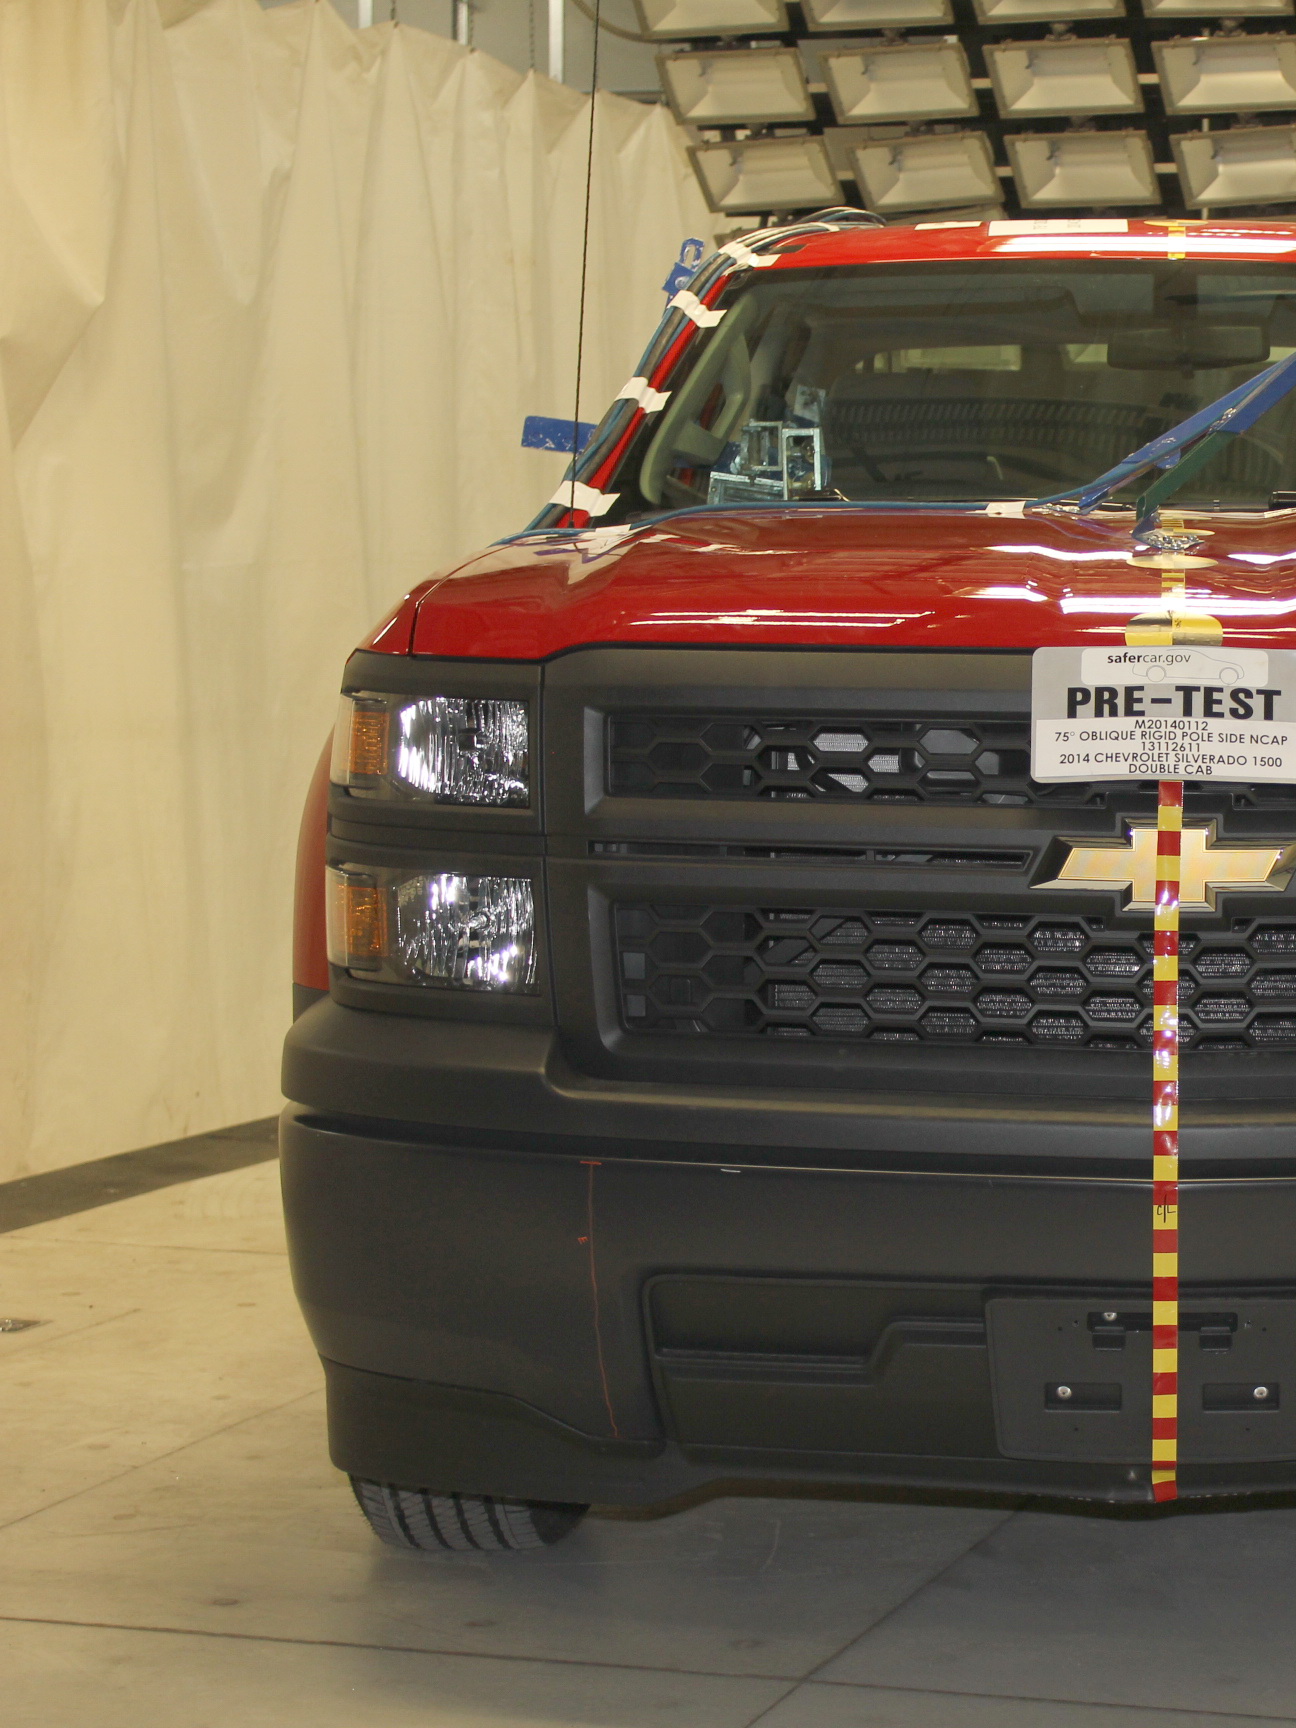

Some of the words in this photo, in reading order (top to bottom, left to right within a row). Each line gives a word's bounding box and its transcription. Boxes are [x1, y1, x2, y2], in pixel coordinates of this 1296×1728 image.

[1107, 652, 1191, 665] safercar.gov
[1067, 685, 1282, 721] PRE-TEST
[1134, 718, 1209, 731] M20140112
[1079, 730, 1136, 741] OBLIQUE
[1140, 730, 1178, 741] RIGID
[1182, 730, 1214, 742] POLE
[1217, 732, 1246, 744] SIDE
[1250, 734, 1288, 745] NCAP
[1141, 740, 1201, 752] 13112611
[1059, 752, 1091, 764] 2014
[1094, 751, 1170, 763] CHEVROLET
[1174, 752, 1248, 765] SILVERADO
[1252, 755, 1282, 768] 1500
[1128, 762, 1180, 774] DOUBLE
[1184, 763, 1213, 775] CAB
